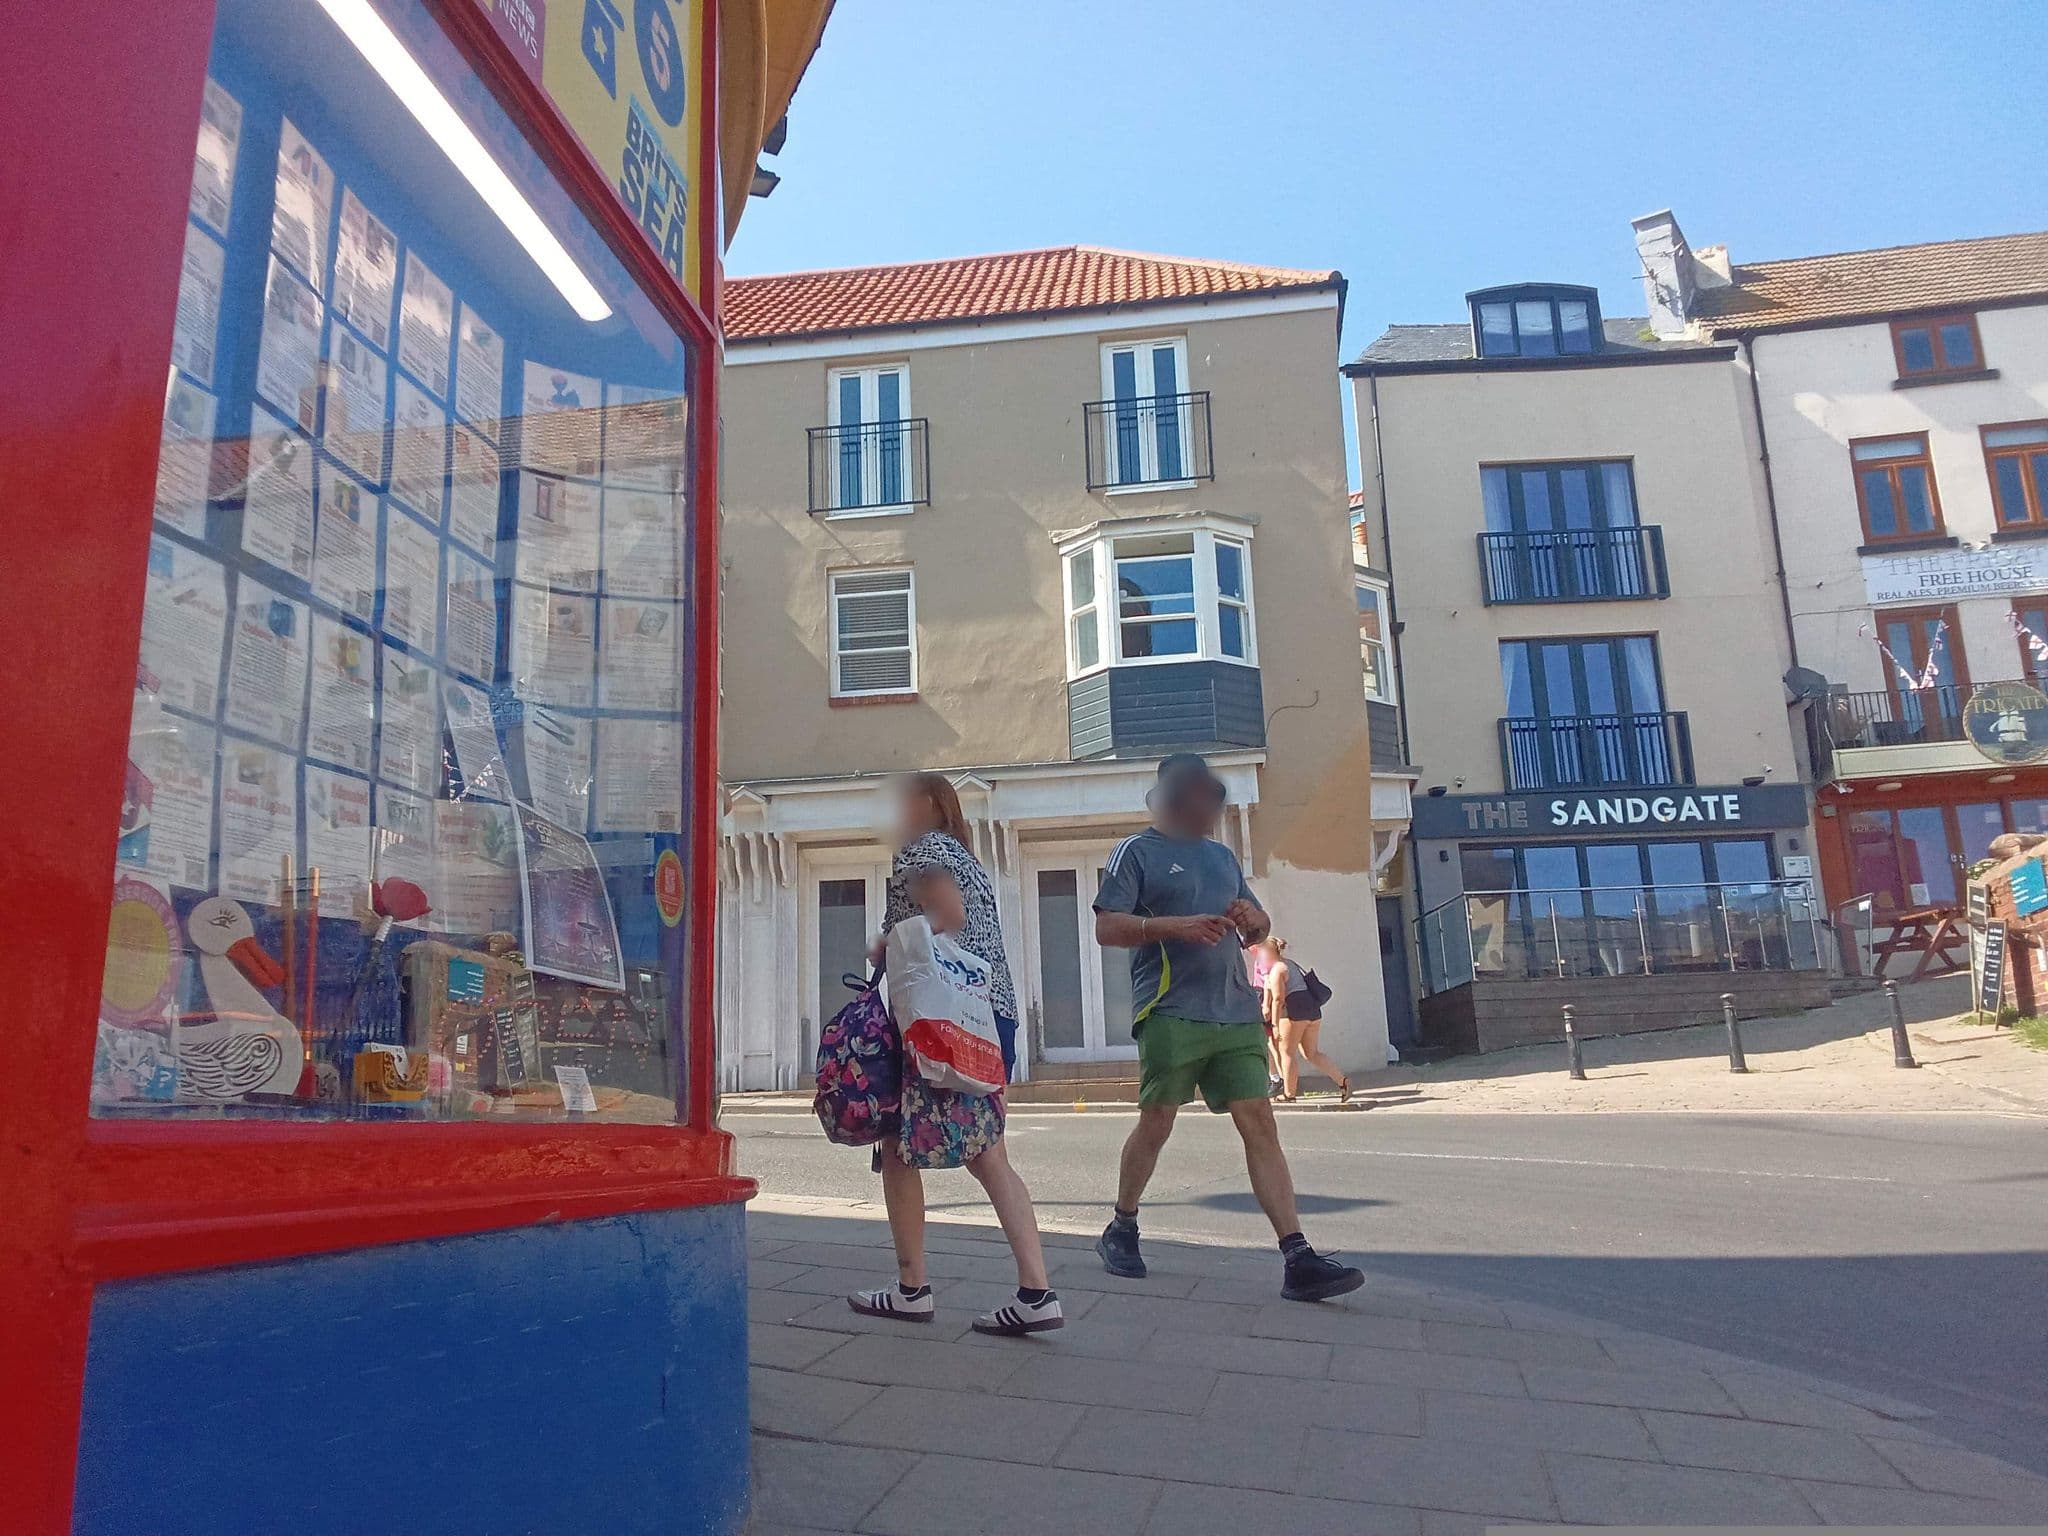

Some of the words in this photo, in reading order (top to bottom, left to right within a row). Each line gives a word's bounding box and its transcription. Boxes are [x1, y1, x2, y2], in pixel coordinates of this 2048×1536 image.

[499, 0, 538, 58] NEWS
[1919, 572, 1964, 587] FREE
[1968, 566, 2034, 584] HOUSE
[1877, 591, 1903, 600] REAL
[1461, 800, 1528, 829] THE
[1551, 794, 1741, 826] SANDGATE
